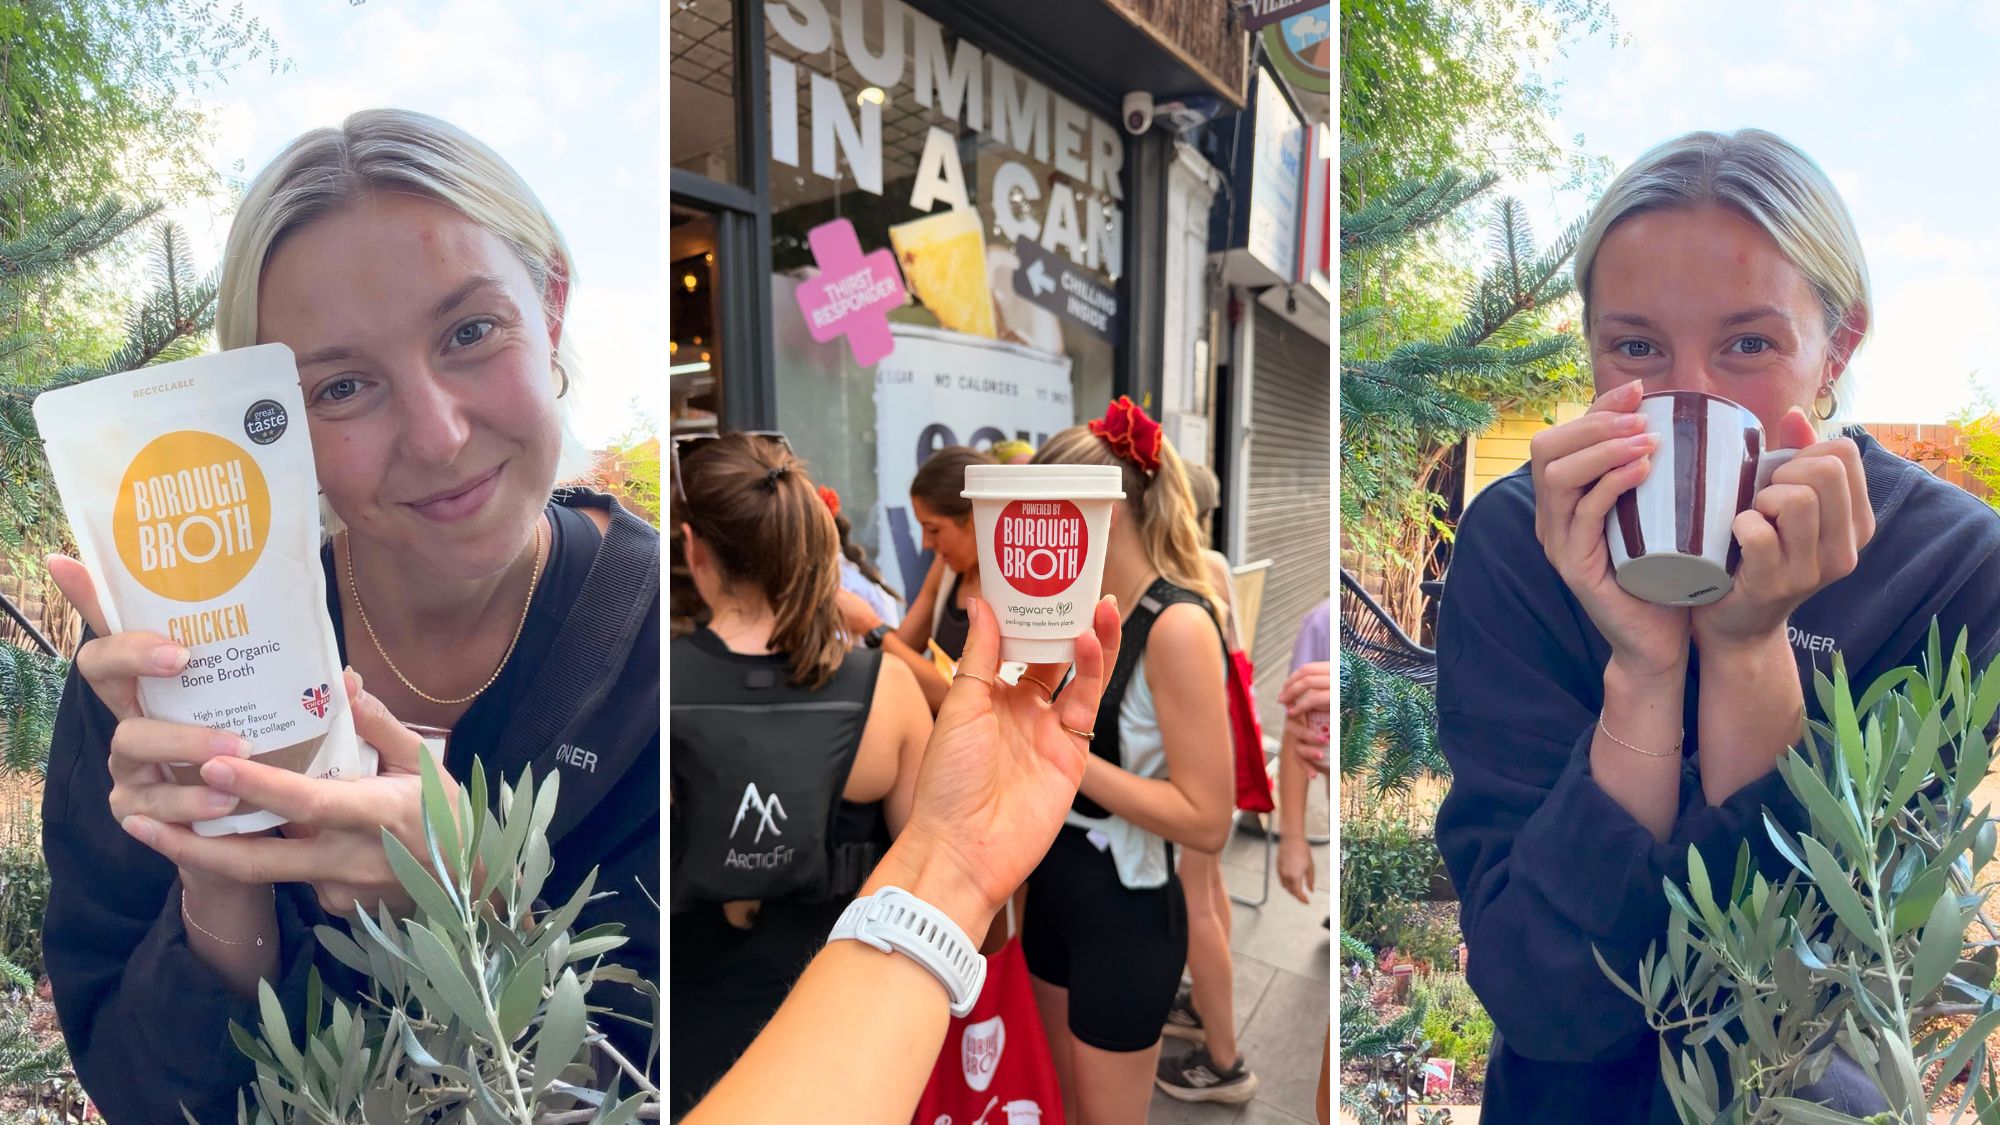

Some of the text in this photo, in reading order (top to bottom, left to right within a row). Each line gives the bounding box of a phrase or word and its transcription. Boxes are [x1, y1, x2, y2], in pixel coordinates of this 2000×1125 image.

[769, 54, 973, 213] IN A
[992, 161, 1124, 278] CAN
[823, 267, 874, 305] THIRST
[1061, 270, 1117, 316] CHILLING
[811, 277, 897, 328] RESPONDER
[1067, 294, 1109, 332] INSIDE
[133, 378, 195, 398] RECYCLABLE
[934, 373, 952, 388] NO
[958, 376, 1020, 397] CALORIES
[247, 414, 286, 434] taste
[254, 408, 276, 421] great
[133, 459, 247, 522] BOROUGH
[1022, 503, 1061, 516] POWERED BY
[138, 504, 254, 572] BROTH
[1003, 517, 1080, 547] BOROUGH
[1003, 547, 1079, 580] BROTH
[1007, 605, 1054, 616] vegware
[168, 604, 249, 647] CHICKEN
[226, 640, 280, 661] Organic
[181, 663, 255, 688] Bone Broth
[193, 702, 257, 721] High in protein
[233, 717, 246, 727] for
[247, 711, 277, 724] flavour
[240, 719, 296, 738] 4.7g collagen
